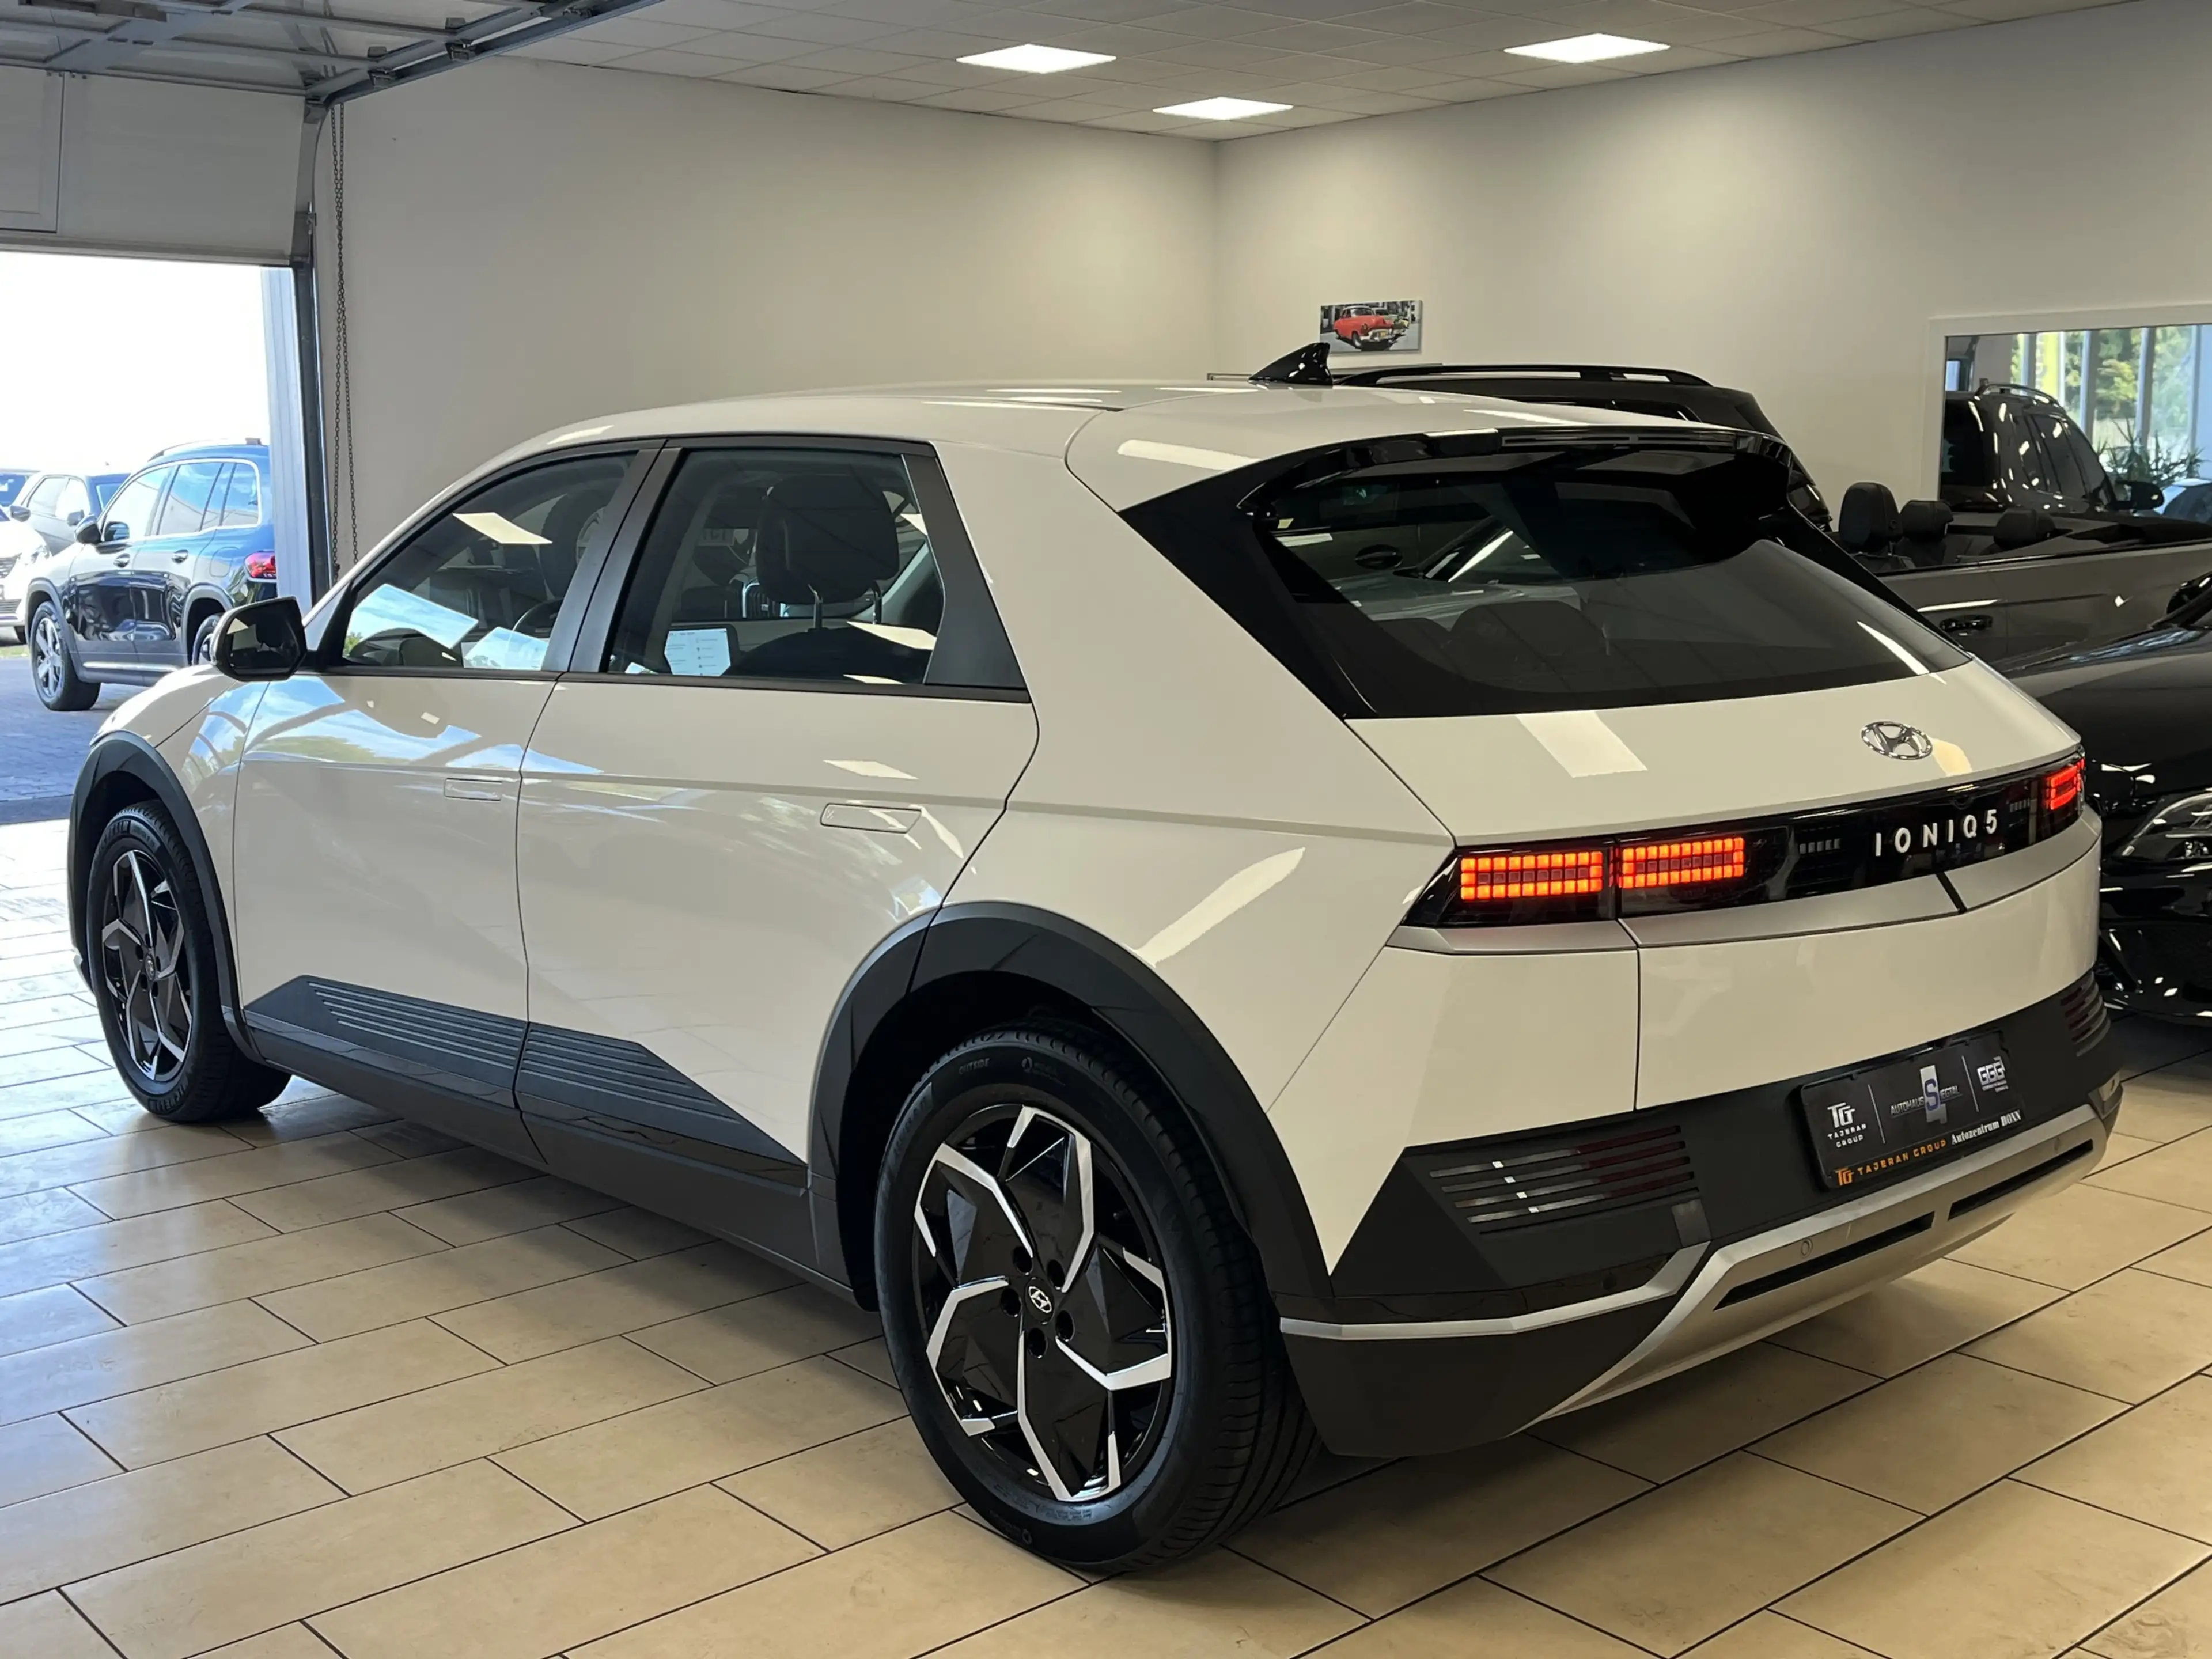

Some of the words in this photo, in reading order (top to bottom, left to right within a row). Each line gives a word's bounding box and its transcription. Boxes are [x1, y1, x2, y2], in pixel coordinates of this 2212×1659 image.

[1875, 814, 1978, 857] IONIQ
[1985, 809, 1998, 834] 5
[1890, 1096, 1925, 1115] AUTOHAUS
[1827, 1123, 1867, 1141] TAJERAN
[1951, 1120, 2000, 1145] Autozentrum
[2000, 1109, 2021, 1127] BONN
[1835, 1134, 1864, 1148] GROUP
[1857, 1152, 1910, 1176] TAJERAN
[1912, 1139, 1947, 1157] GROUP
